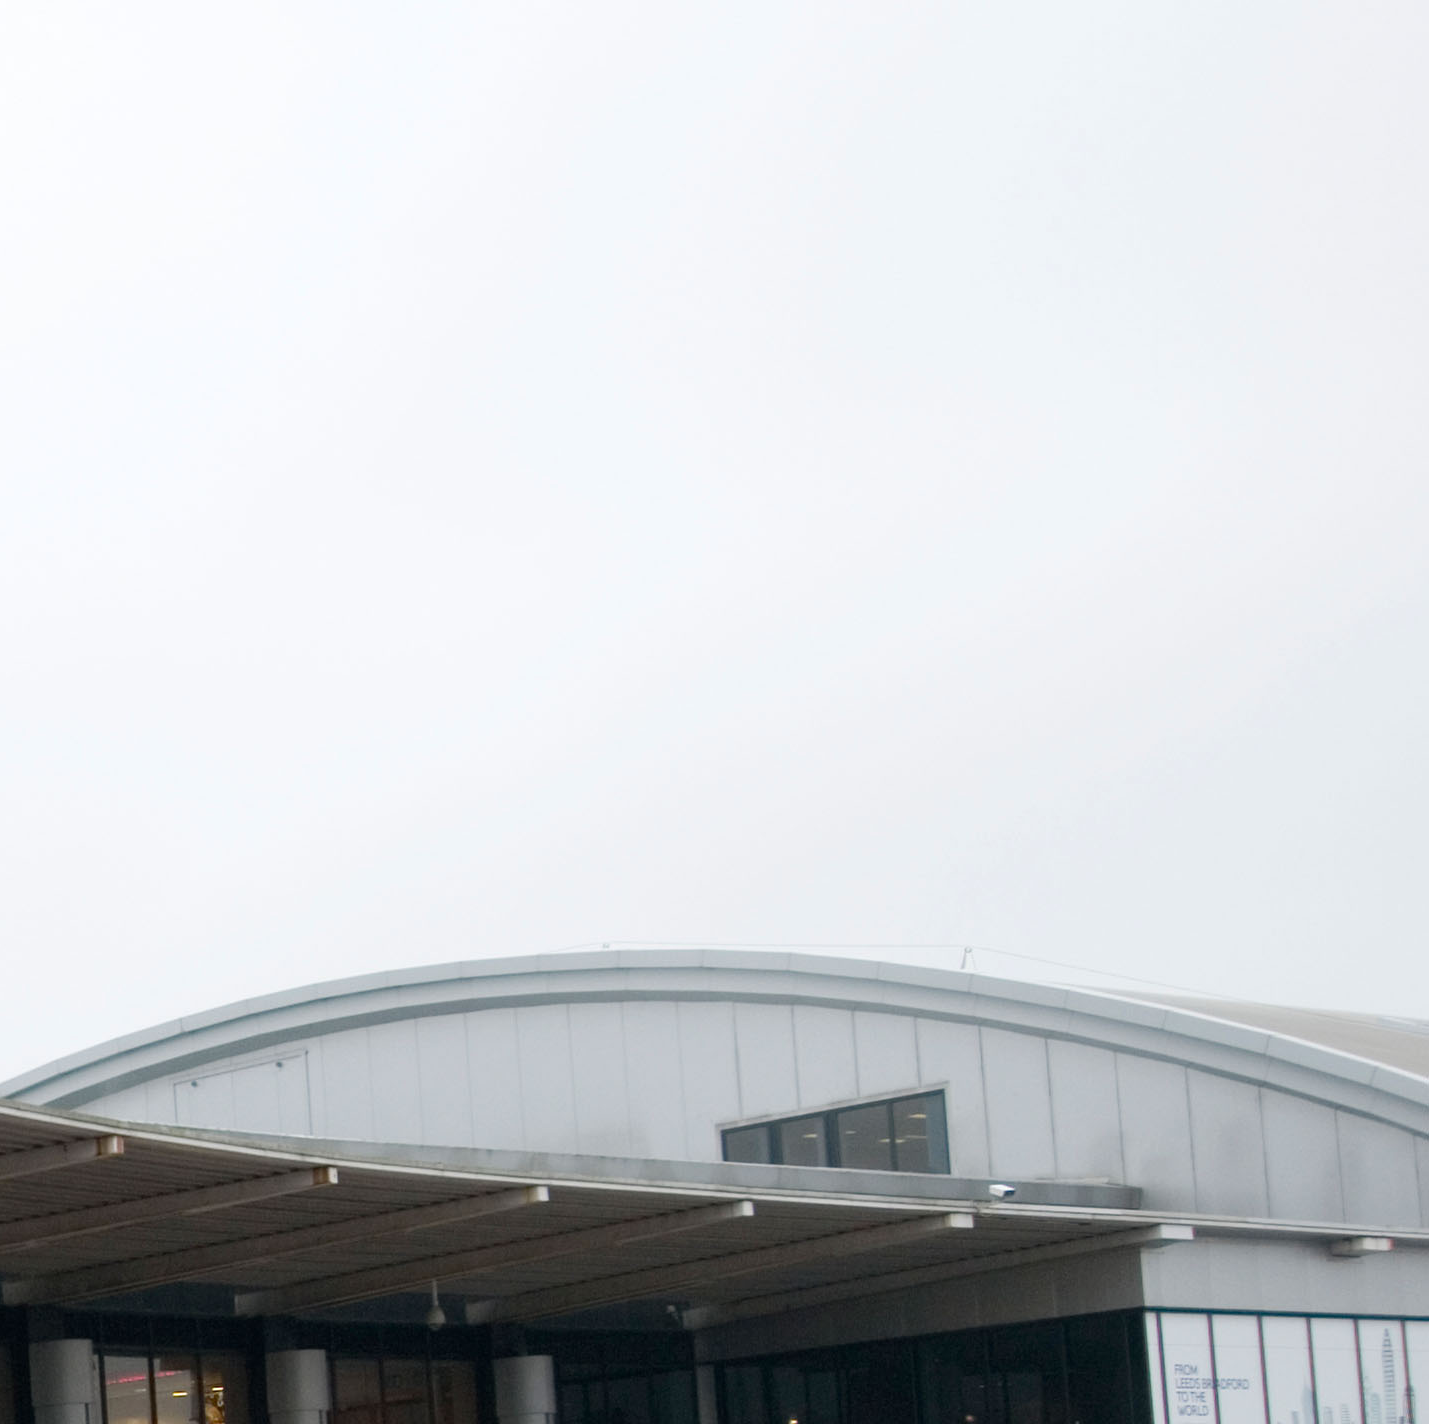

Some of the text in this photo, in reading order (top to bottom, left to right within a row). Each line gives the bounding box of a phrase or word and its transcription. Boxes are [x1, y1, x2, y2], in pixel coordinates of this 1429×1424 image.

[1174, 1363, 1198, 1376] FROM
[1175, 1377, 1200, 1390] LEEDS
[1176, 1390, 1207, 1403] TO THE
[1178, 1404, 1209, 1417] WORLD
